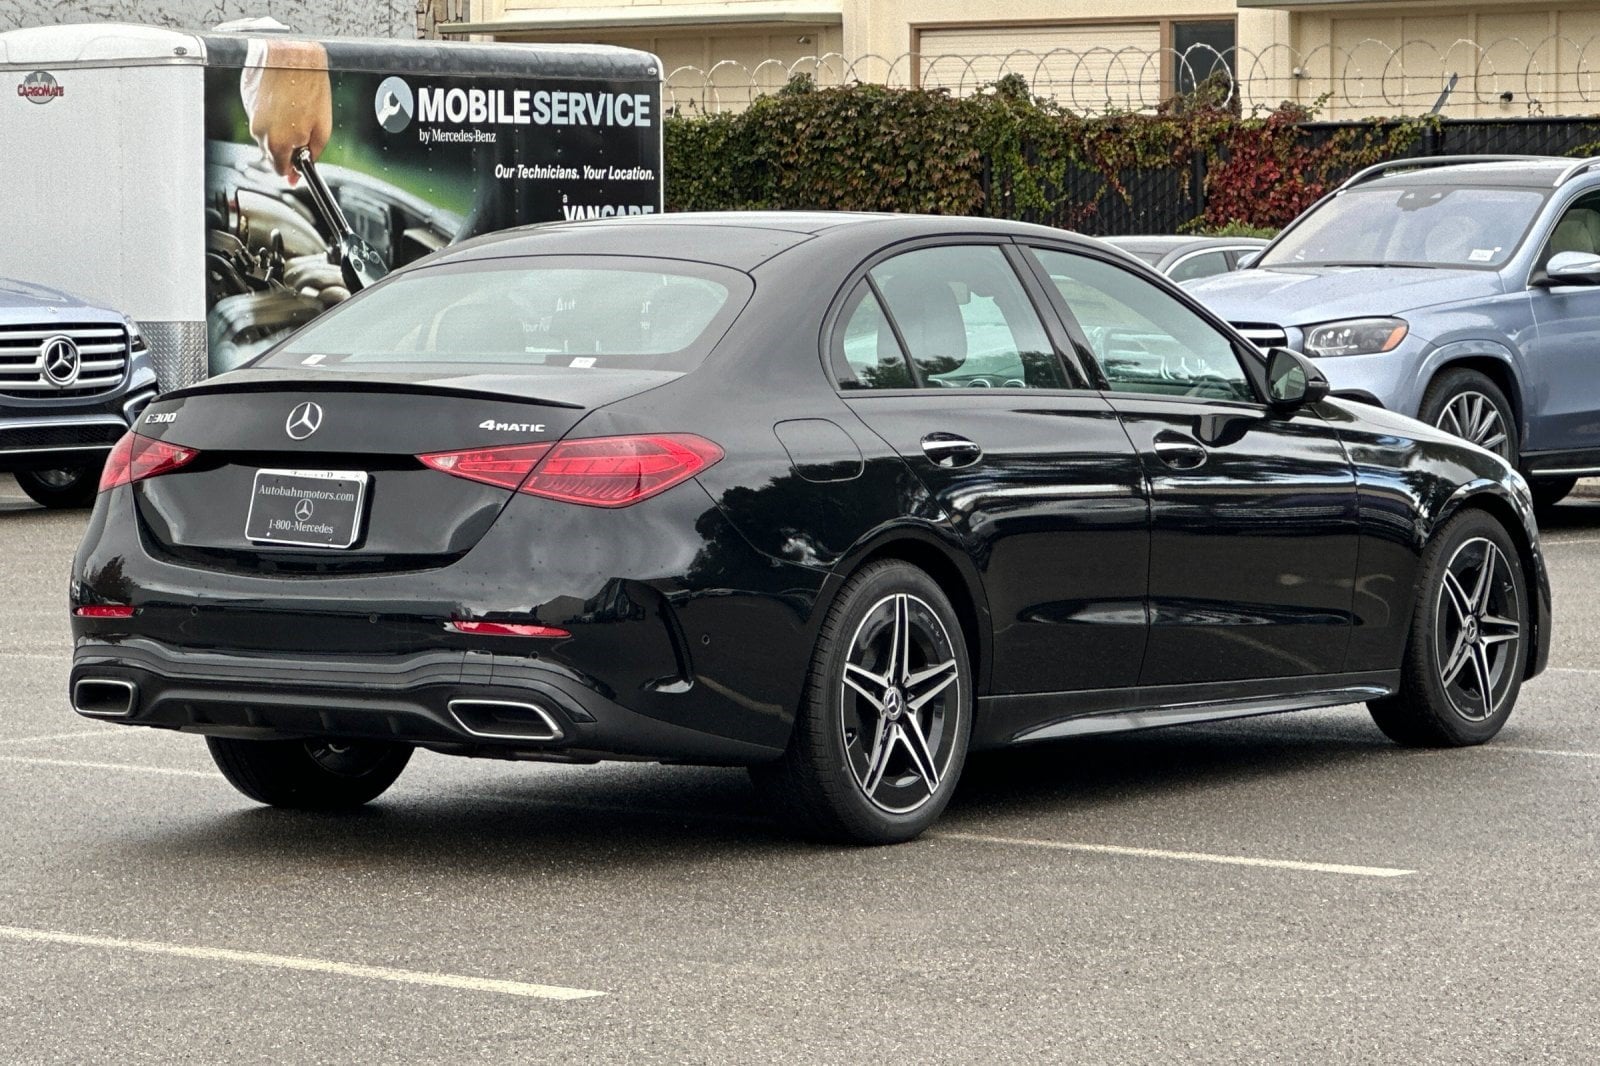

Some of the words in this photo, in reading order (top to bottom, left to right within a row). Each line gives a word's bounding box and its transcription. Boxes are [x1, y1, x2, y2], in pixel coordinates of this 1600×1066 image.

[419, 129, 430, 144] by
[432, 129, 497, 143] Mercedes-Benz
[495, 164, 515, 179] Our
[517, 164, 580, 179] Technicians.
[583, 166, 607, 179] Your
[608, 166, 655, 180] Location.
[478, 419, 546, 432] 4MATIC
[258, 484, 354, 502] Autobahnmotors.com
[268, 519, 333, 534] 1-800-Mercedes
